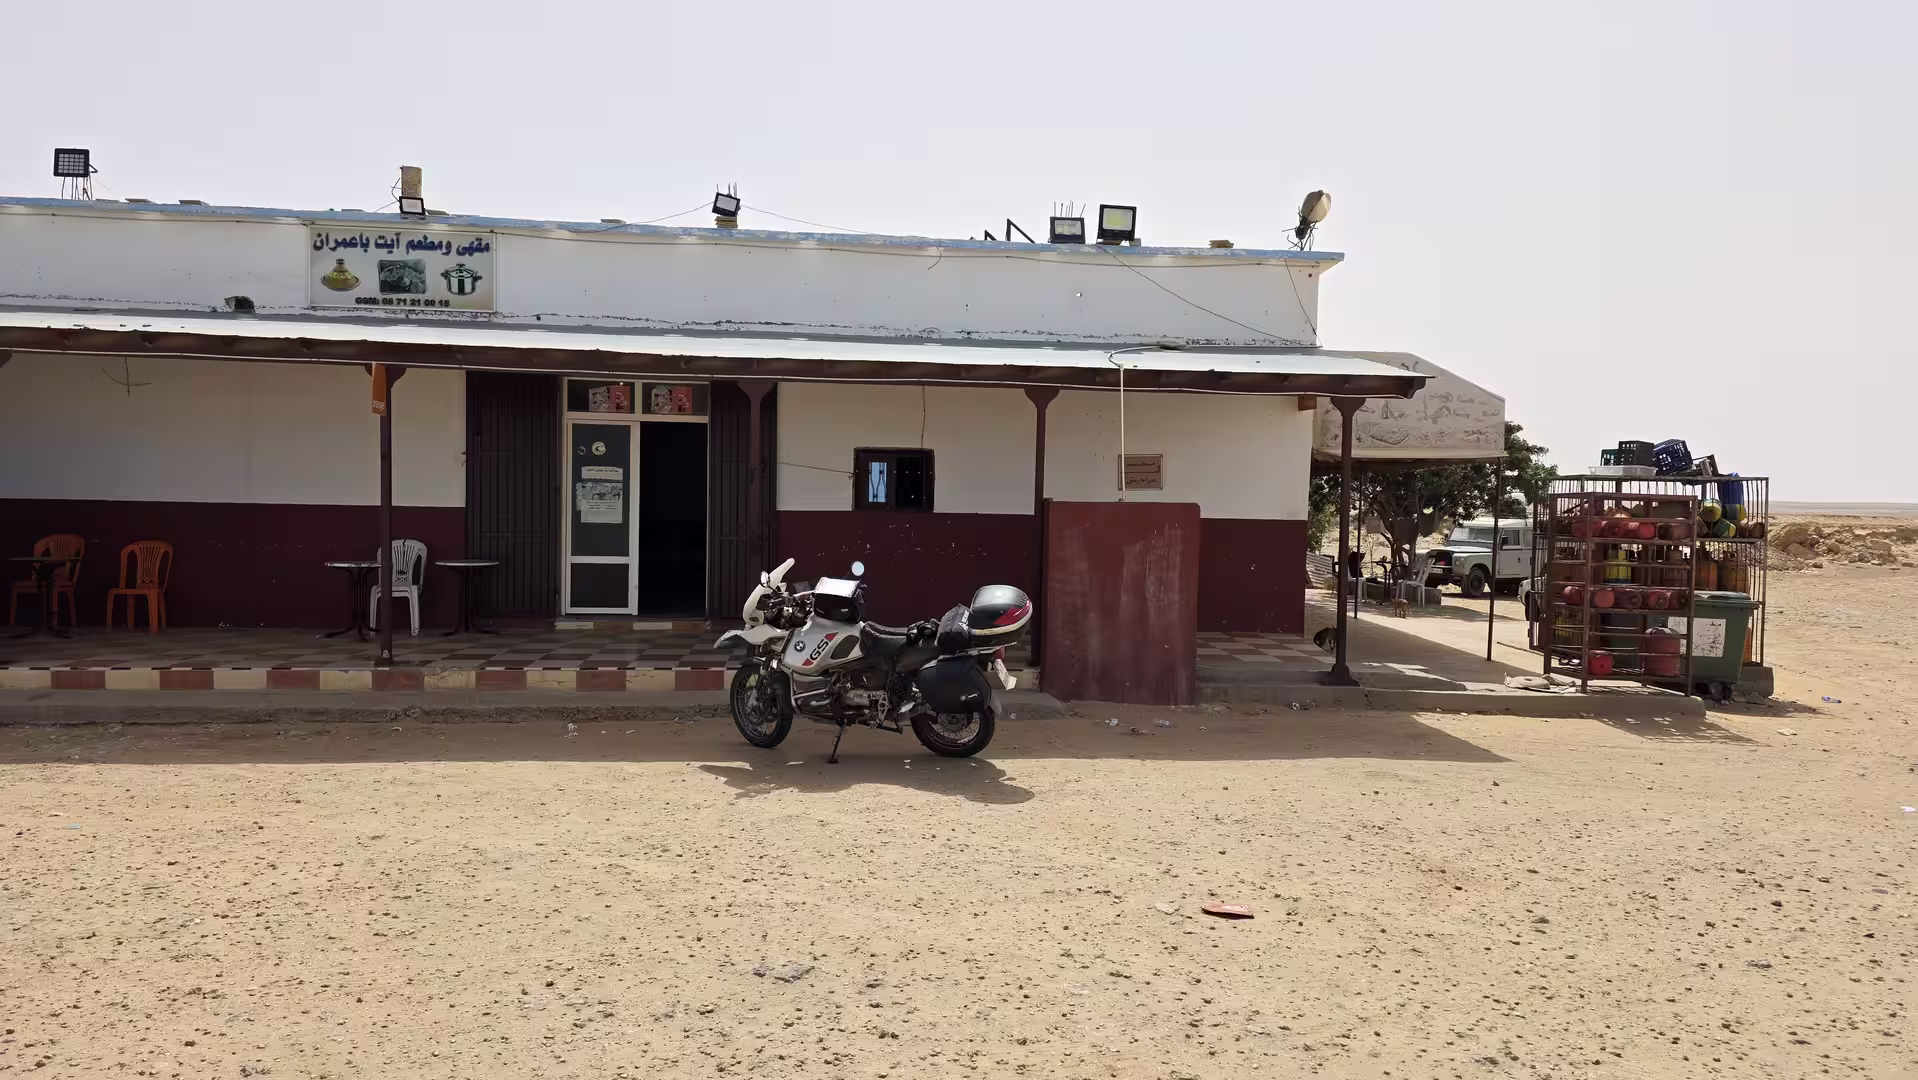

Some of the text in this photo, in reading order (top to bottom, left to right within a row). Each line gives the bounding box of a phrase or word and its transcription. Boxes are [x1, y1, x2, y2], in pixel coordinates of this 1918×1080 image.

[312, 232, 490, 257] مقهى ومطعم آيت باعمران
[355, 297, 379, 306] GSM:
[396, 298, 407, 306] 71
[410, 298, 421, 307] 21
[810, 638, 829, 661] GS
